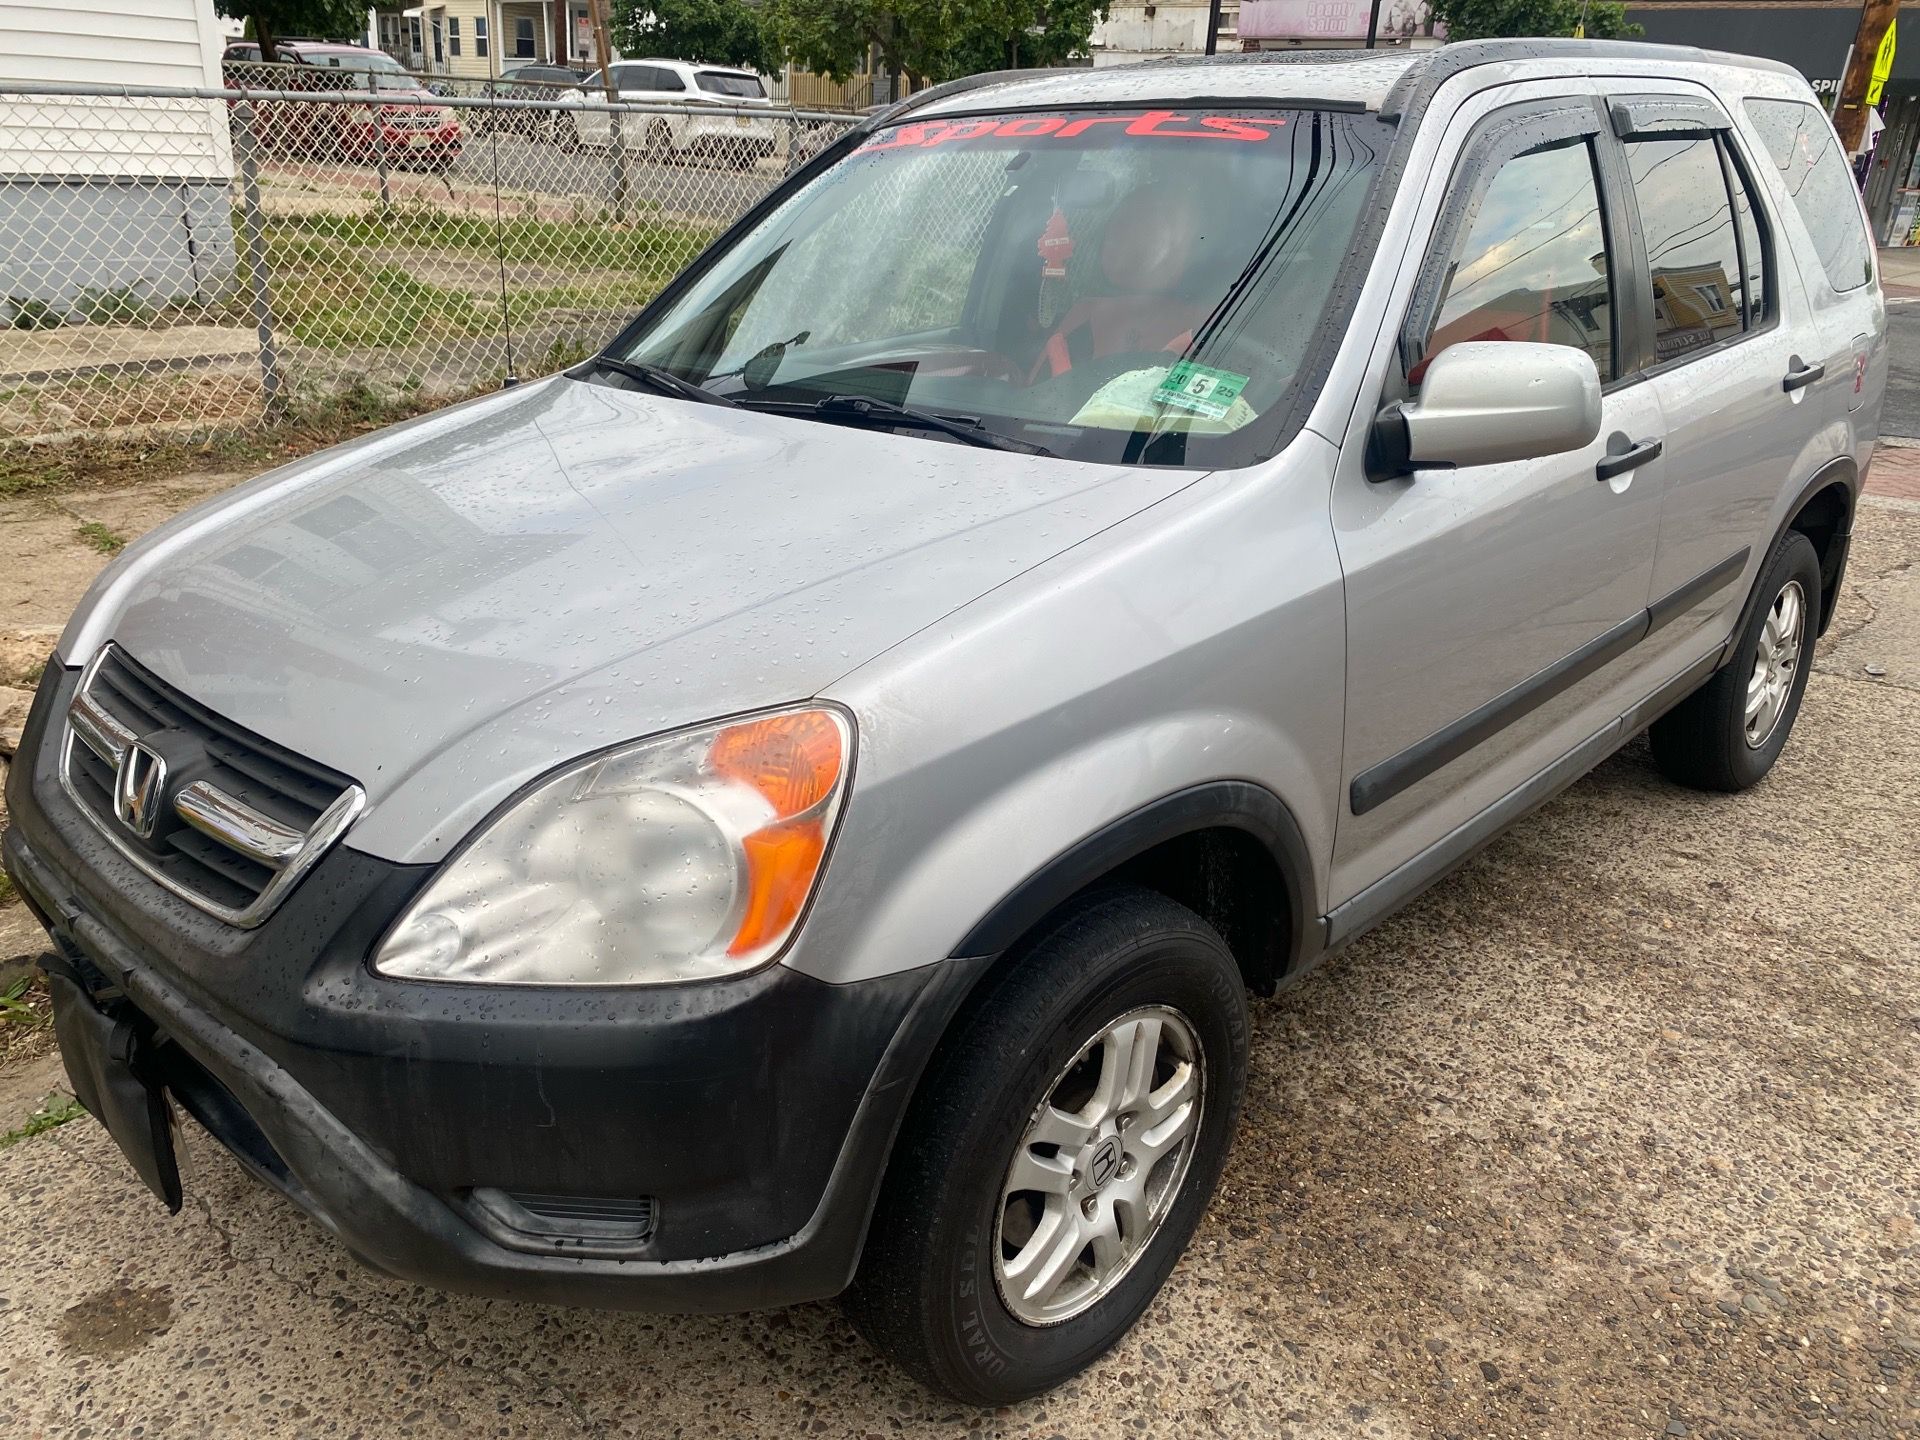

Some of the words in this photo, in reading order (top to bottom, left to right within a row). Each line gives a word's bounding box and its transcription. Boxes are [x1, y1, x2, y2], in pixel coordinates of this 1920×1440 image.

[1307, 2, 1354, 17] Beauty
[1308, 17, 1347, 33] Salon
[1169, 373, 1188, 385] 20
[1192, 378, 1209, 394] 5
[1216, 384, 1236, 398] 25
